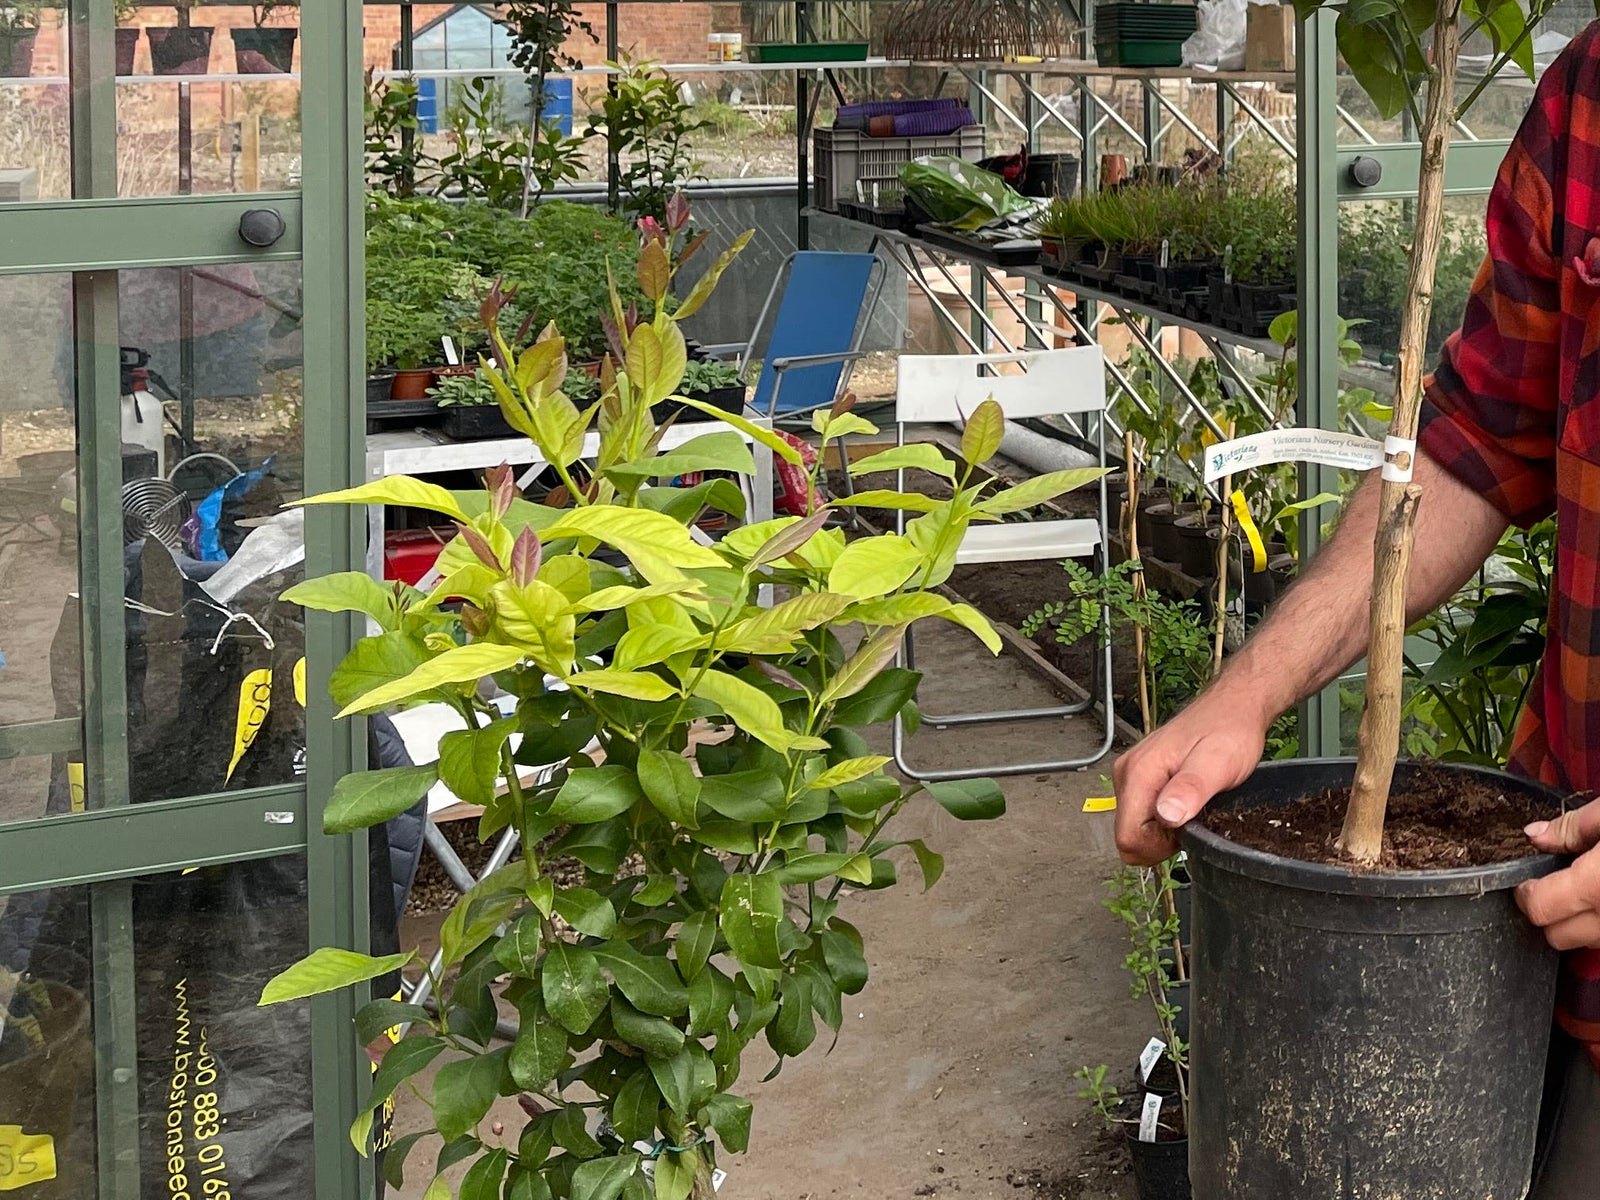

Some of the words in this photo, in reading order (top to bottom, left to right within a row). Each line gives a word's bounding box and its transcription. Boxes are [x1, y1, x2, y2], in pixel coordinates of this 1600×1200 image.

[1273, 436, 1312, 445] Victoriana
[1313, 435, 1345, 448] Nursery
[193, 1092, 220, 1140] 883
